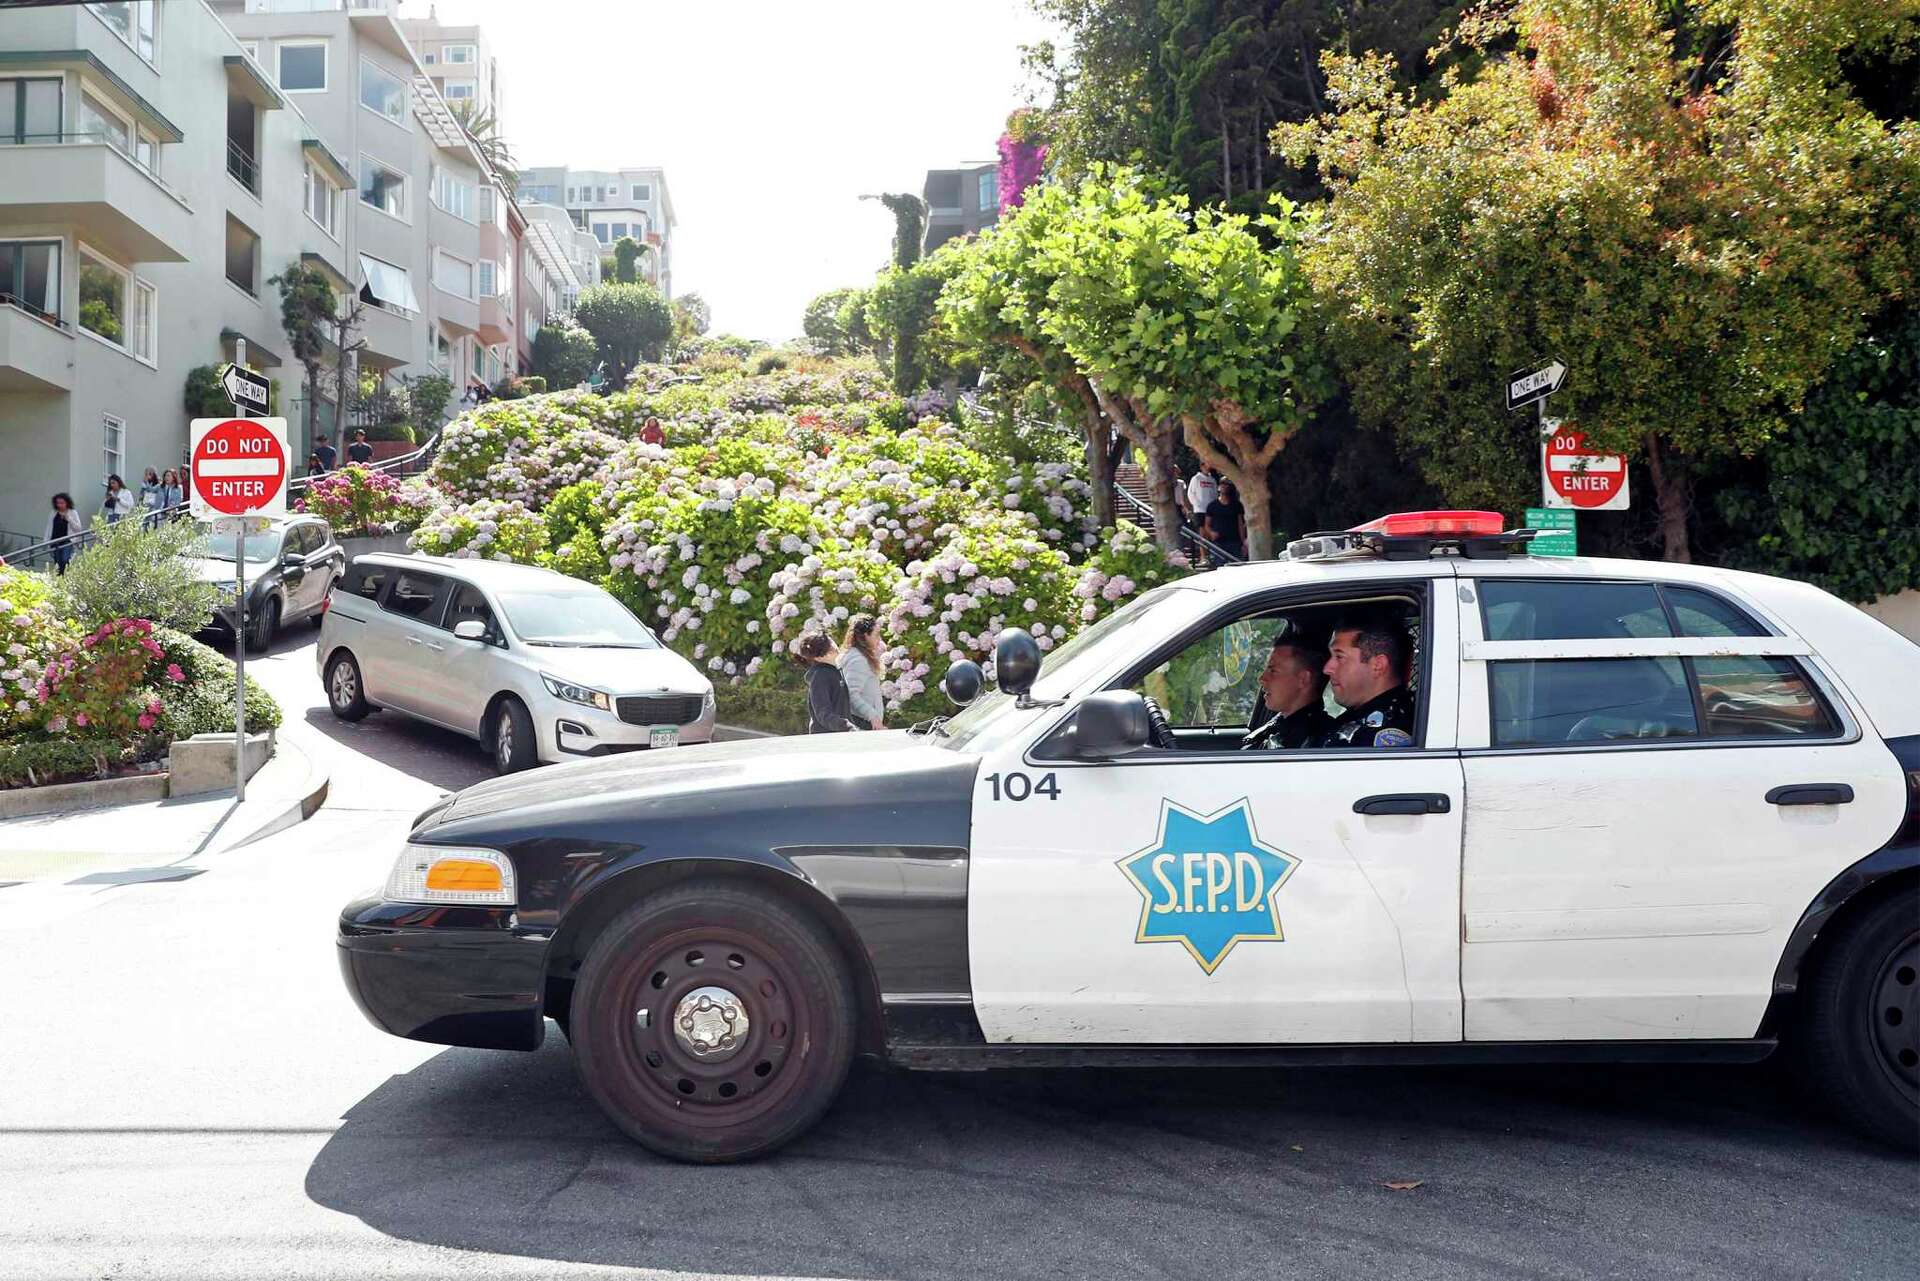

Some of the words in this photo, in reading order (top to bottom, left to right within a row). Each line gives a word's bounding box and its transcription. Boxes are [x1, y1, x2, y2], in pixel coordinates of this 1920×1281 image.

[235, 378, 249, 397] ONE
[250, 384, 265, 402] WAY
[1514, 378, 1531, 396] ONE
[1533, 369, 1550, 388] WAY
[206, 439, 229, 454] DO
[239, 438, 271, 453] NOT
[1556, 436, 1576, 451] DO
[212, 481, 264, 497] ENTER
[1563, 476, 1610, 491] ENTER
[984, 772, 1062, 801] 104
[1151, 851, 1266, 914] S.F.P.D.
